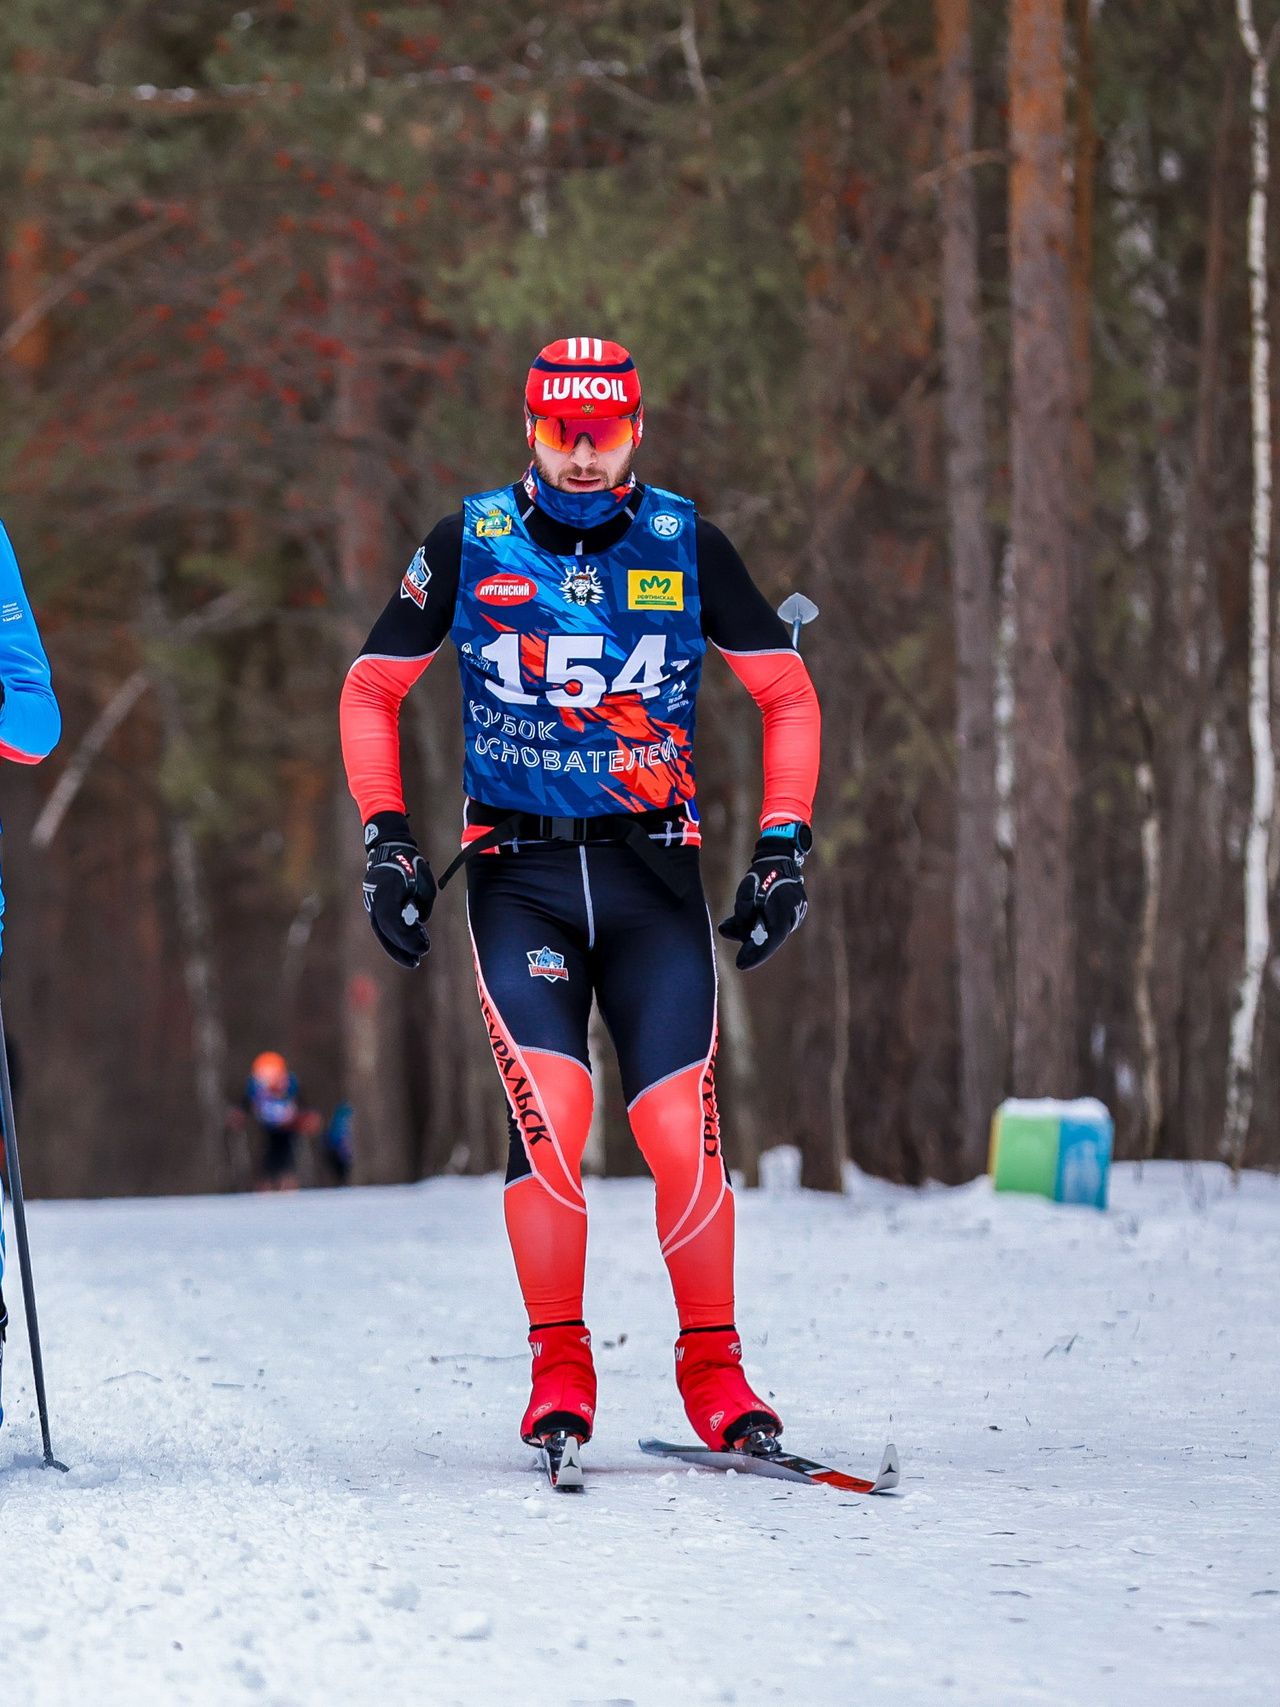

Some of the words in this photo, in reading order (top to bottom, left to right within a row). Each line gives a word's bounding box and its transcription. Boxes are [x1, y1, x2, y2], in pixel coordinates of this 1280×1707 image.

[542, 377, 628, 402] LUKOIL
[481, 633, 671, 709] 154
[468, 699, 559, 742] КУБОК
[475, 733, 678, 773] ОСНОВАТЕЛЕЙ
